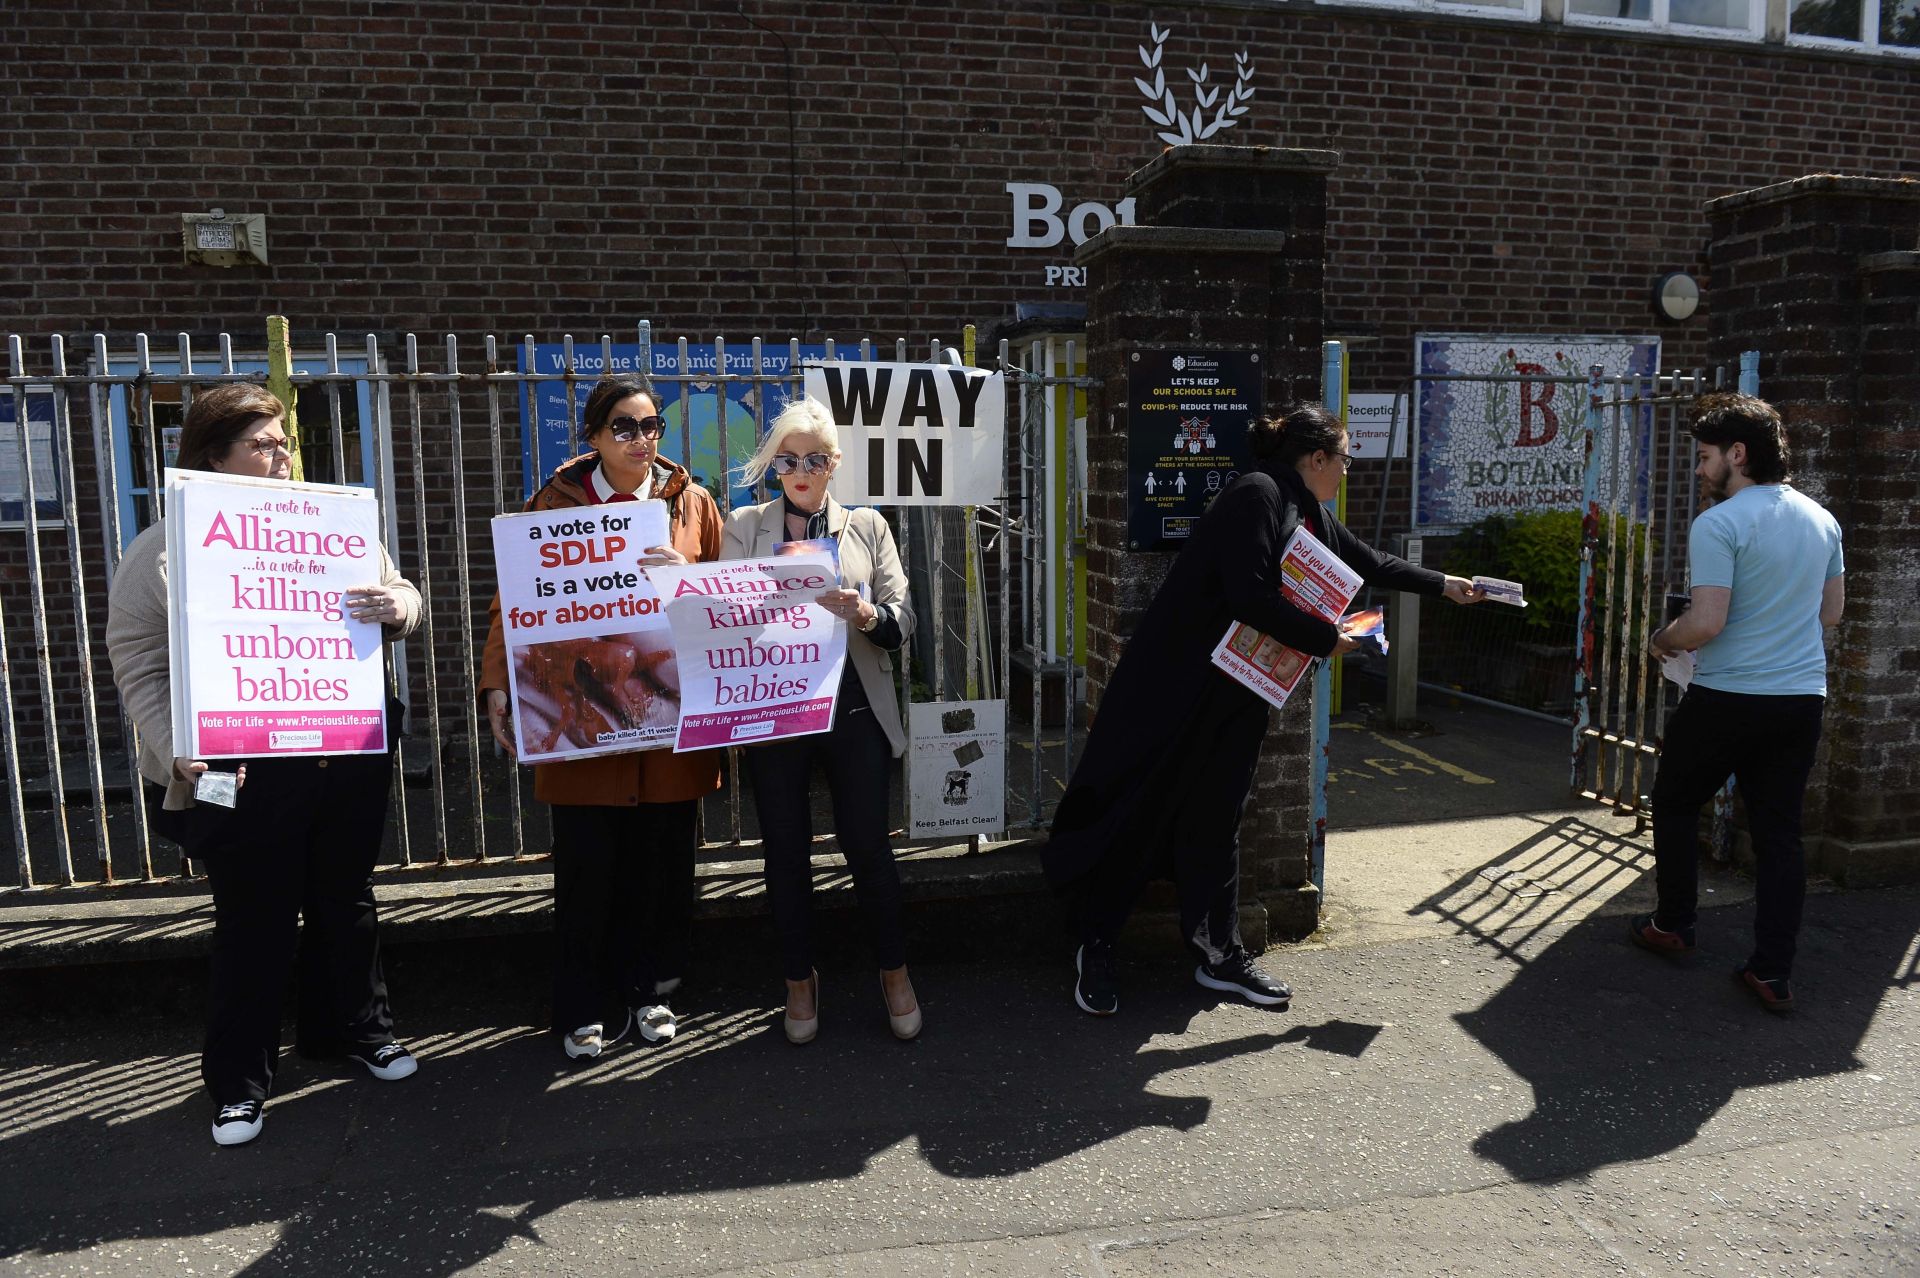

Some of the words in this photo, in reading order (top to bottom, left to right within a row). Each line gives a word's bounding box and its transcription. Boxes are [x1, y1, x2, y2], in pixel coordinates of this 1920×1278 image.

[1153, 388, 1170, 396] OUR
[1174, 388, 1212, 396] SCHOOLS
[1215, 388, 1236, 396] SAFE
[1172, 378, 1194, 386] LET'S
[1198, 378, 1220, 386] KEEP
[824, 367, 989, 428] WAY
[1514, 363, 1559, 447] B
[1347, 405, 1400, 417] Receptio
[1356, 430, 1392, 438] Entranc
[866, 438, 943, 497] IN
[276, 500, 300, 514] vote
[303, 502, 320, 516] for
[1474, 489, 1534, 508] PRIMARY
[202, 510, 366, 558] Alliance
[529, 526, 542, 540] a
[548, 519, 596, 538] vote
[600, 515, 632, 532] for
[540, 536, 626, 568] SDLP
[1293, 540, 1312, 558] Did
[1306, 556, 1326, 571] you
[270, 561, 278, 572] a
[282, 560, 306, 574] vote
[308, 560, 326, 574] for
[732, 565, 754, 573] vote
[758, 563, 776, 571] for
[535, 577, 556, 598] is
[562, 580, 578, 594] a
[584, 571, 638, 592] vote
[674, 574, 826, 598] Alliance
[230, 575, 344, 622] killing
[508, 607, 547, 629] for
[703, 604, 811, 630] killing
[222, 625, 356, 660] unborn
[706, 637, 820, 670] unborn
[232, 666, 348, 702] babies
[714, 673, 808, 706] babies
[1219, 651, 1230, 664] Vote
[1228, 661, 1240, 673] only
[1238, 665, 1246, 674] for
[1245, 669, 1263, 687] Pro-Life
[1261, 682, 1284, 702] Candidates
[201, 716, 224, 728] Vote
[226, 716, 243, 727] For
[246, 716, 264, 727] Life
[276, 715, 380, 726] www.PreciousLife.com
[684, 719, 700, 729] Vote
[702, 717, 714, 726] For
[717, 715, 732, 724] Life
[741, 701, 830, 722] www.PreciousLife.com
[598, 732, 616, 741] baby
[618, 730, 637, 739] killed
[916, 820, 936, 828] Keep
[940, 816, 969, 826] Belfast
[972, 816, 998, 824] Clean!
